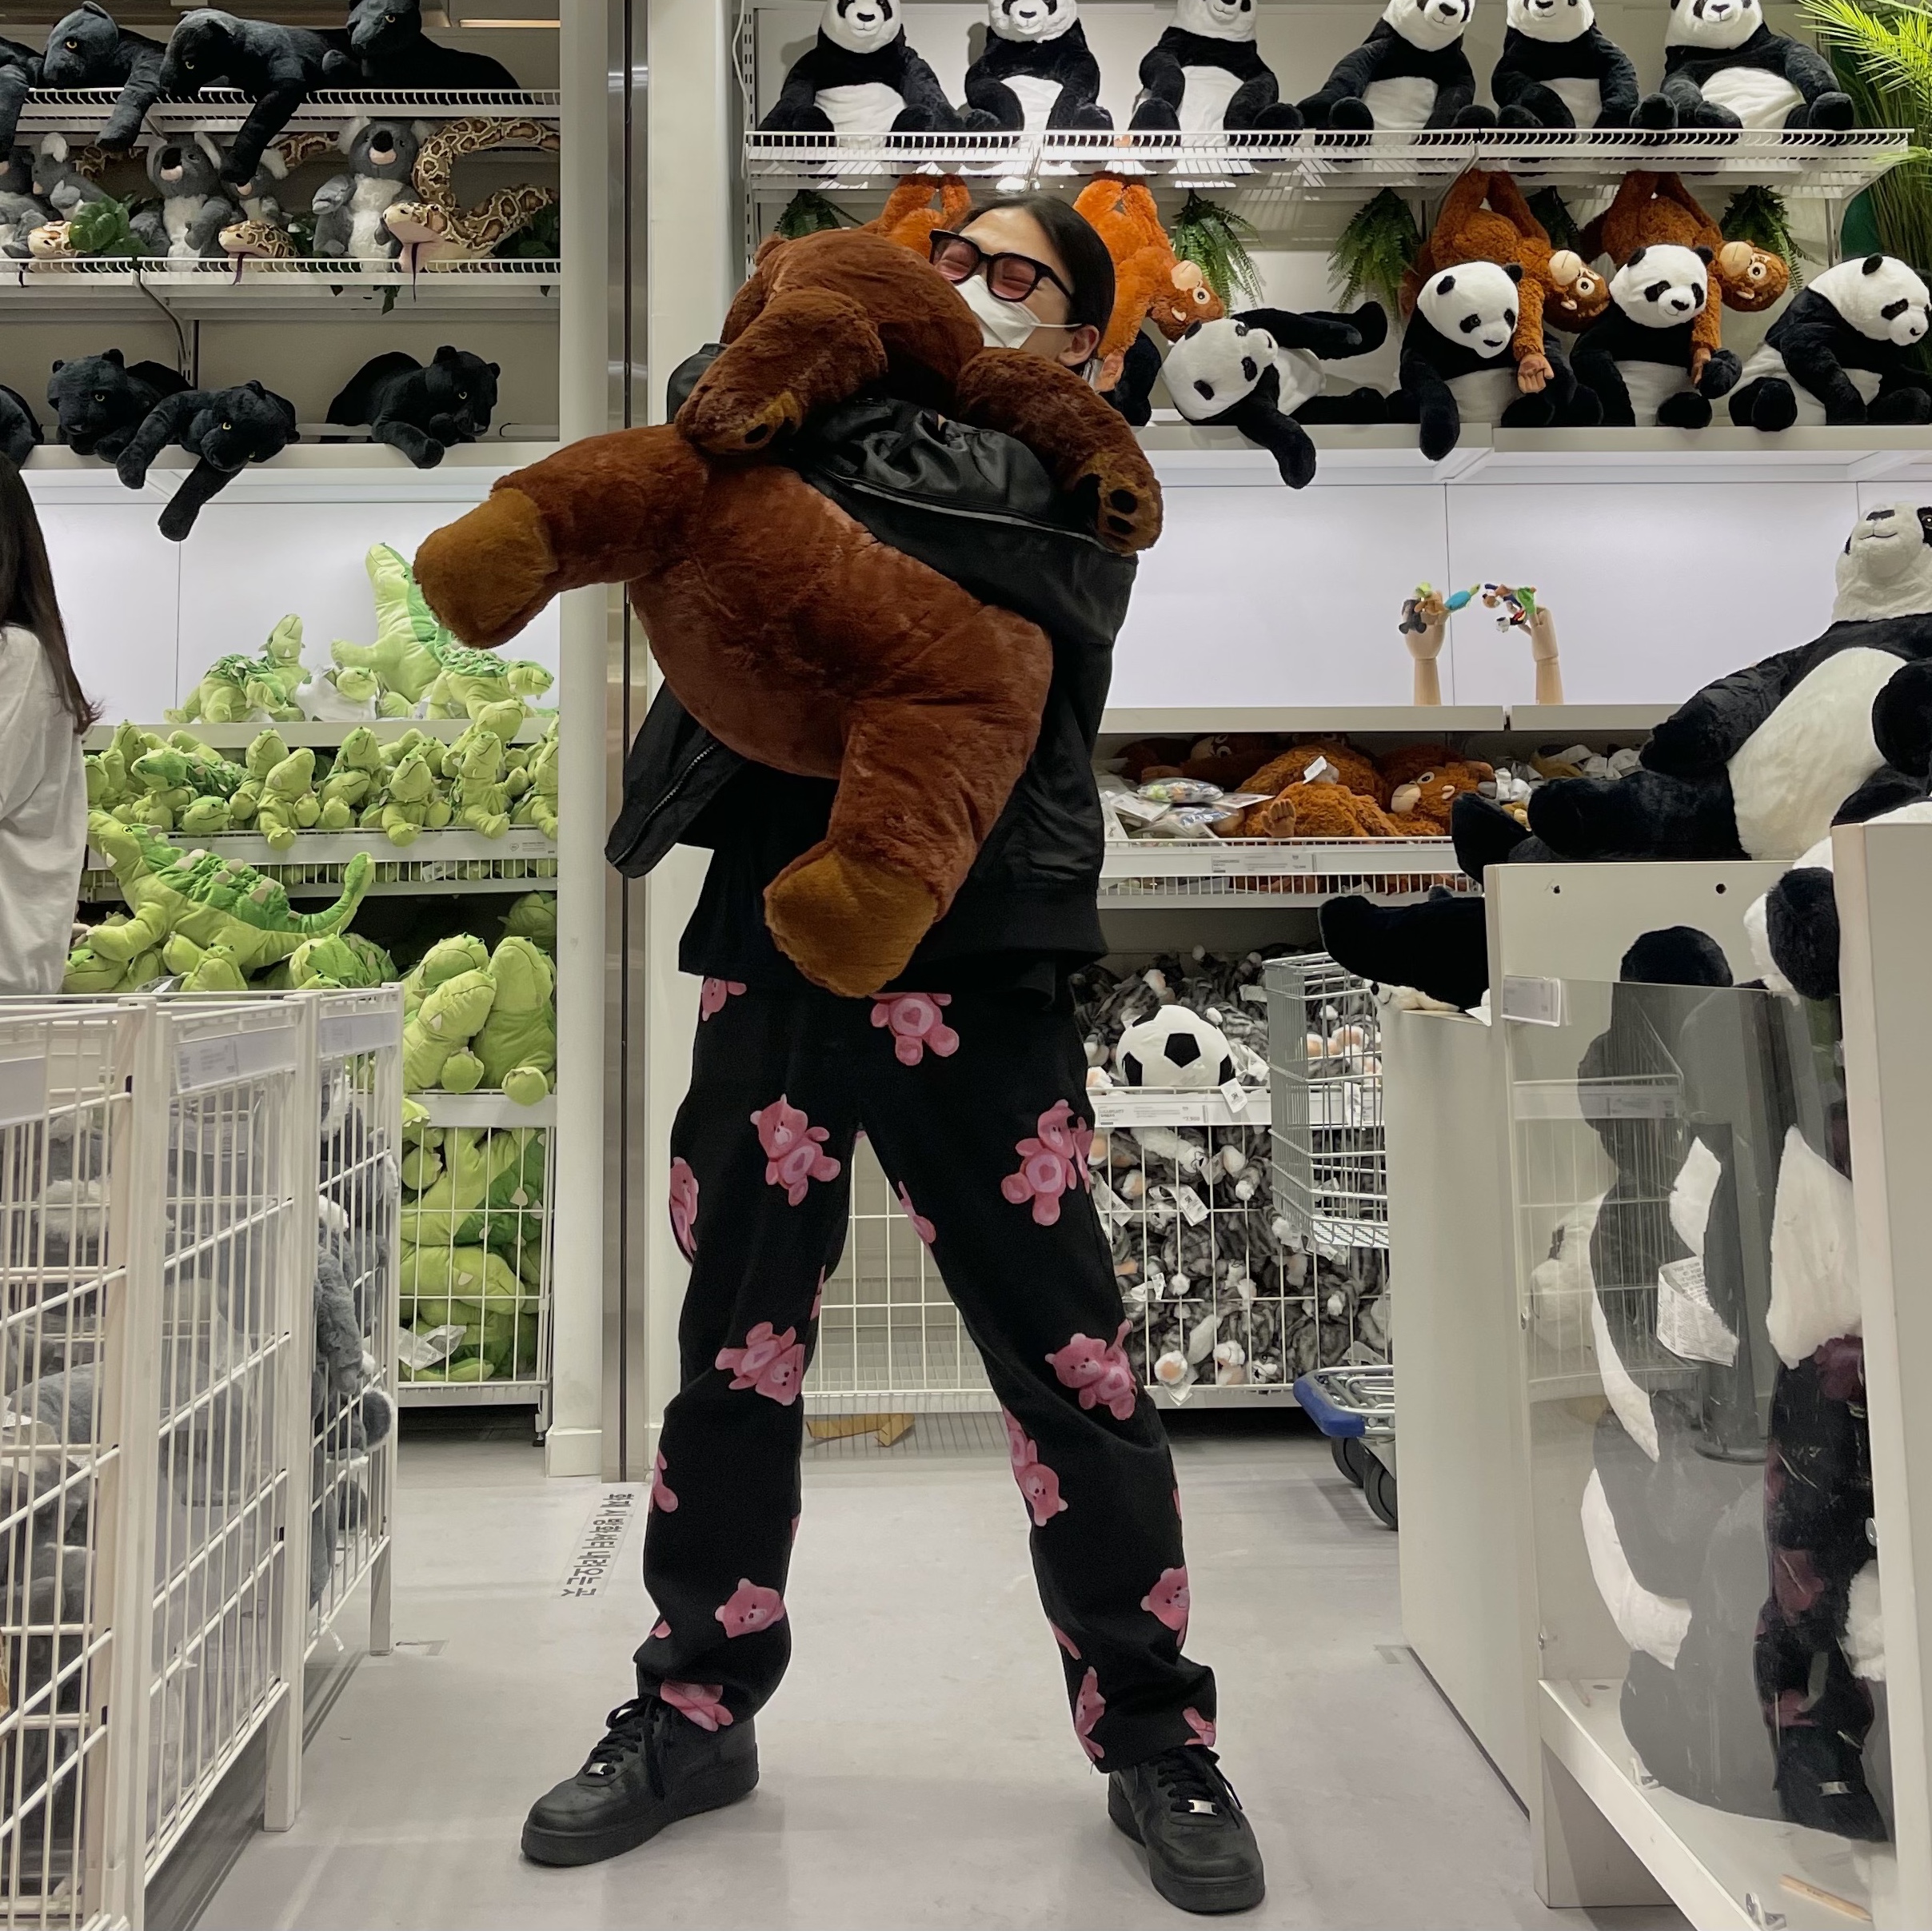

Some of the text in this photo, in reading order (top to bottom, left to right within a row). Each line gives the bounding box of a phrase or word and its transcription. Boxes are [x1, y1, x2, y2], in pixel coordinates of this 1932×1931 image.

[600, 1494, 634, 1508] 화재
[581, 1518, 624, 1549] 방화셔터
[566, 1550, 611, 1586] 내려오는
[561, 1587, 597, 1598] 곳
